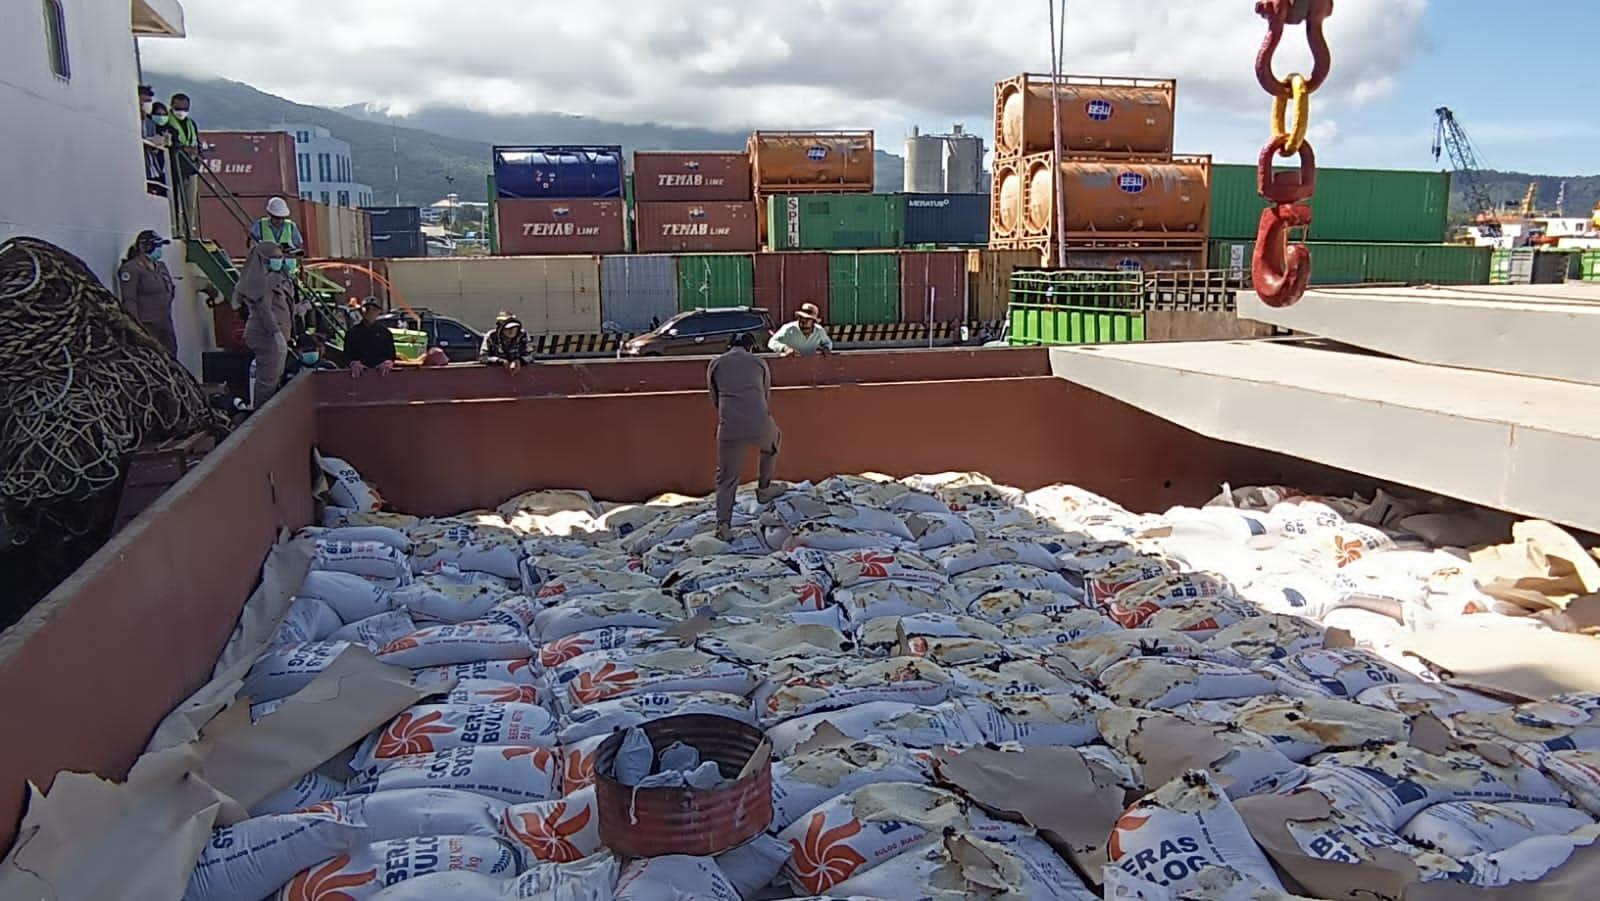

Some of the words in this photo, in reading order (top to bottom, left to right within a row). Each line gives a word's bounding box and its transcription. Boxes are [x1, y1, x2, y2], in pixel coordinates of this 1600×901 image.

[225, 164, 253, 173] LINE
[576, 226, 600, 236] LINE
[1120, 837, 1199, 876] ERAS
[1145, 856, 1209, 887] LOG
